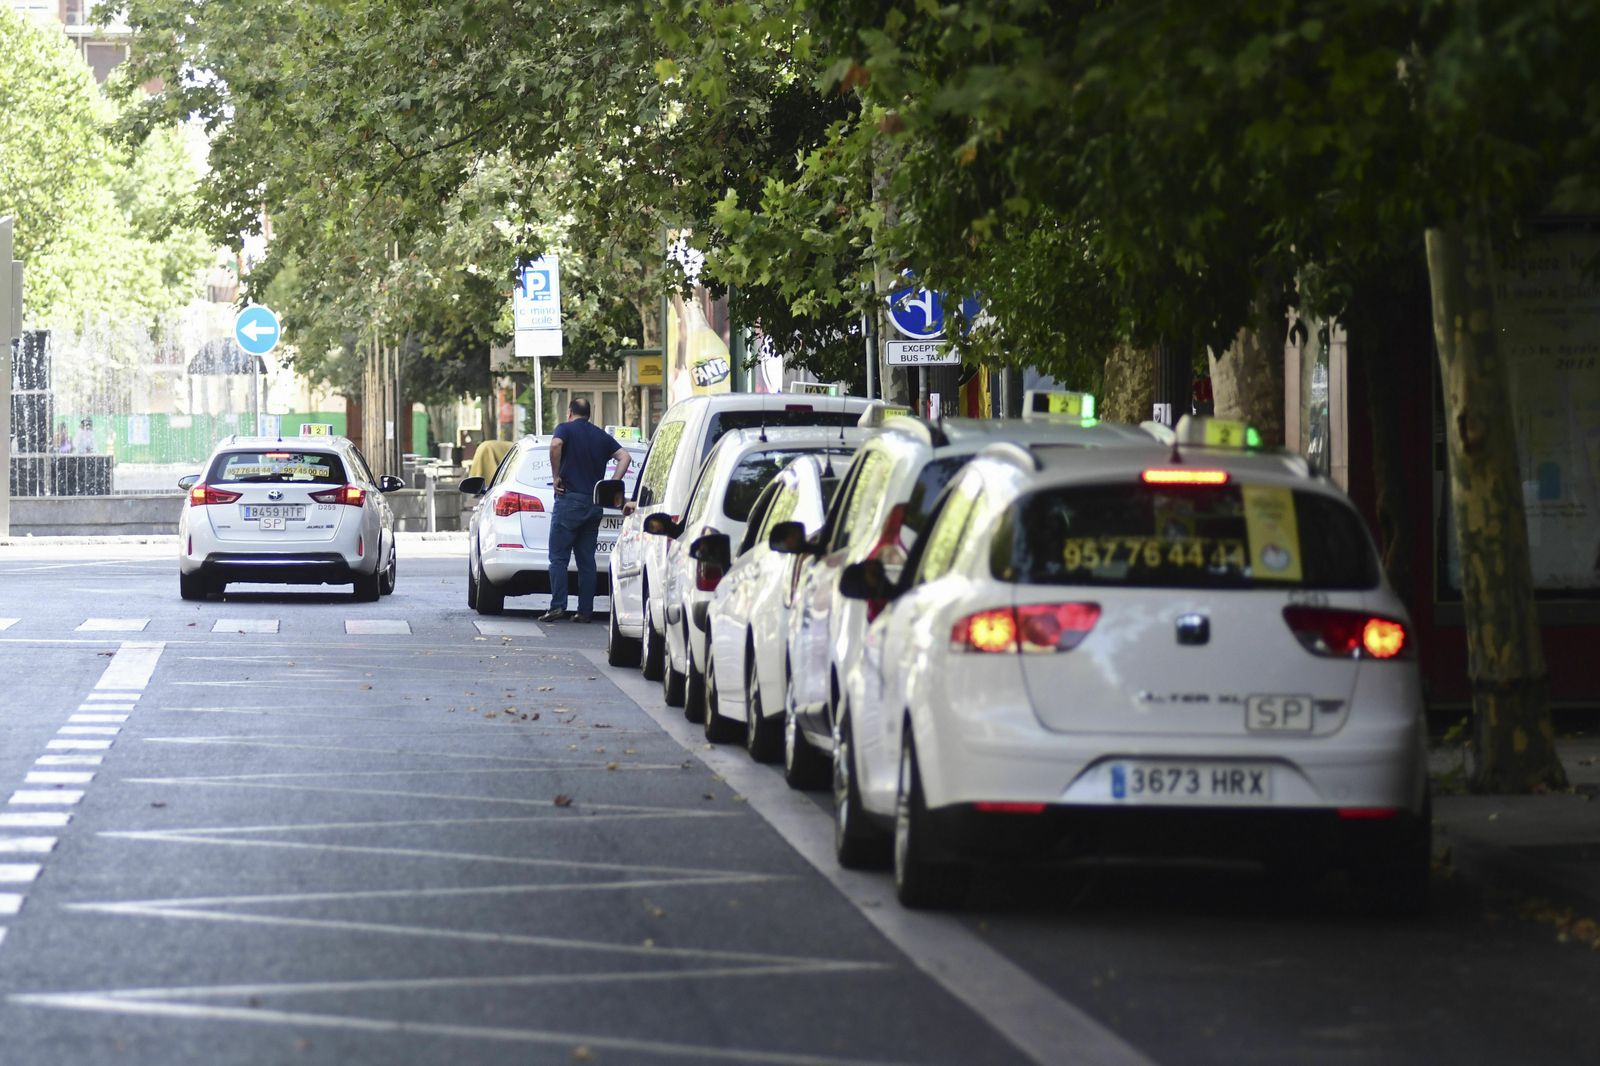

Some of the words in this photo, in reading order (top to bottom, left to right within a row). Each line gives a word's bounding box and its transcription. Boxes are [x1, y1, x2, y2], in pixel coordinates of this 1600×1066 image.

[1060, 400, 1069, 412] 2
[1222, 428, 1230, 442] 2
[252, 507, 279, 517] 8459
[283, 507, 304, 517] HTF
[264, 518, 282, 528] SP
[1064, 542, 1116, 571] 957
[1125, 541, 1161, 567] 76
[1167, 542, 1203, 567] 44
[1257, 698, 1302, 728] SP
[1132, 769, 1200, 794] 3673
[1212, 770, 1263, 794] HRX
